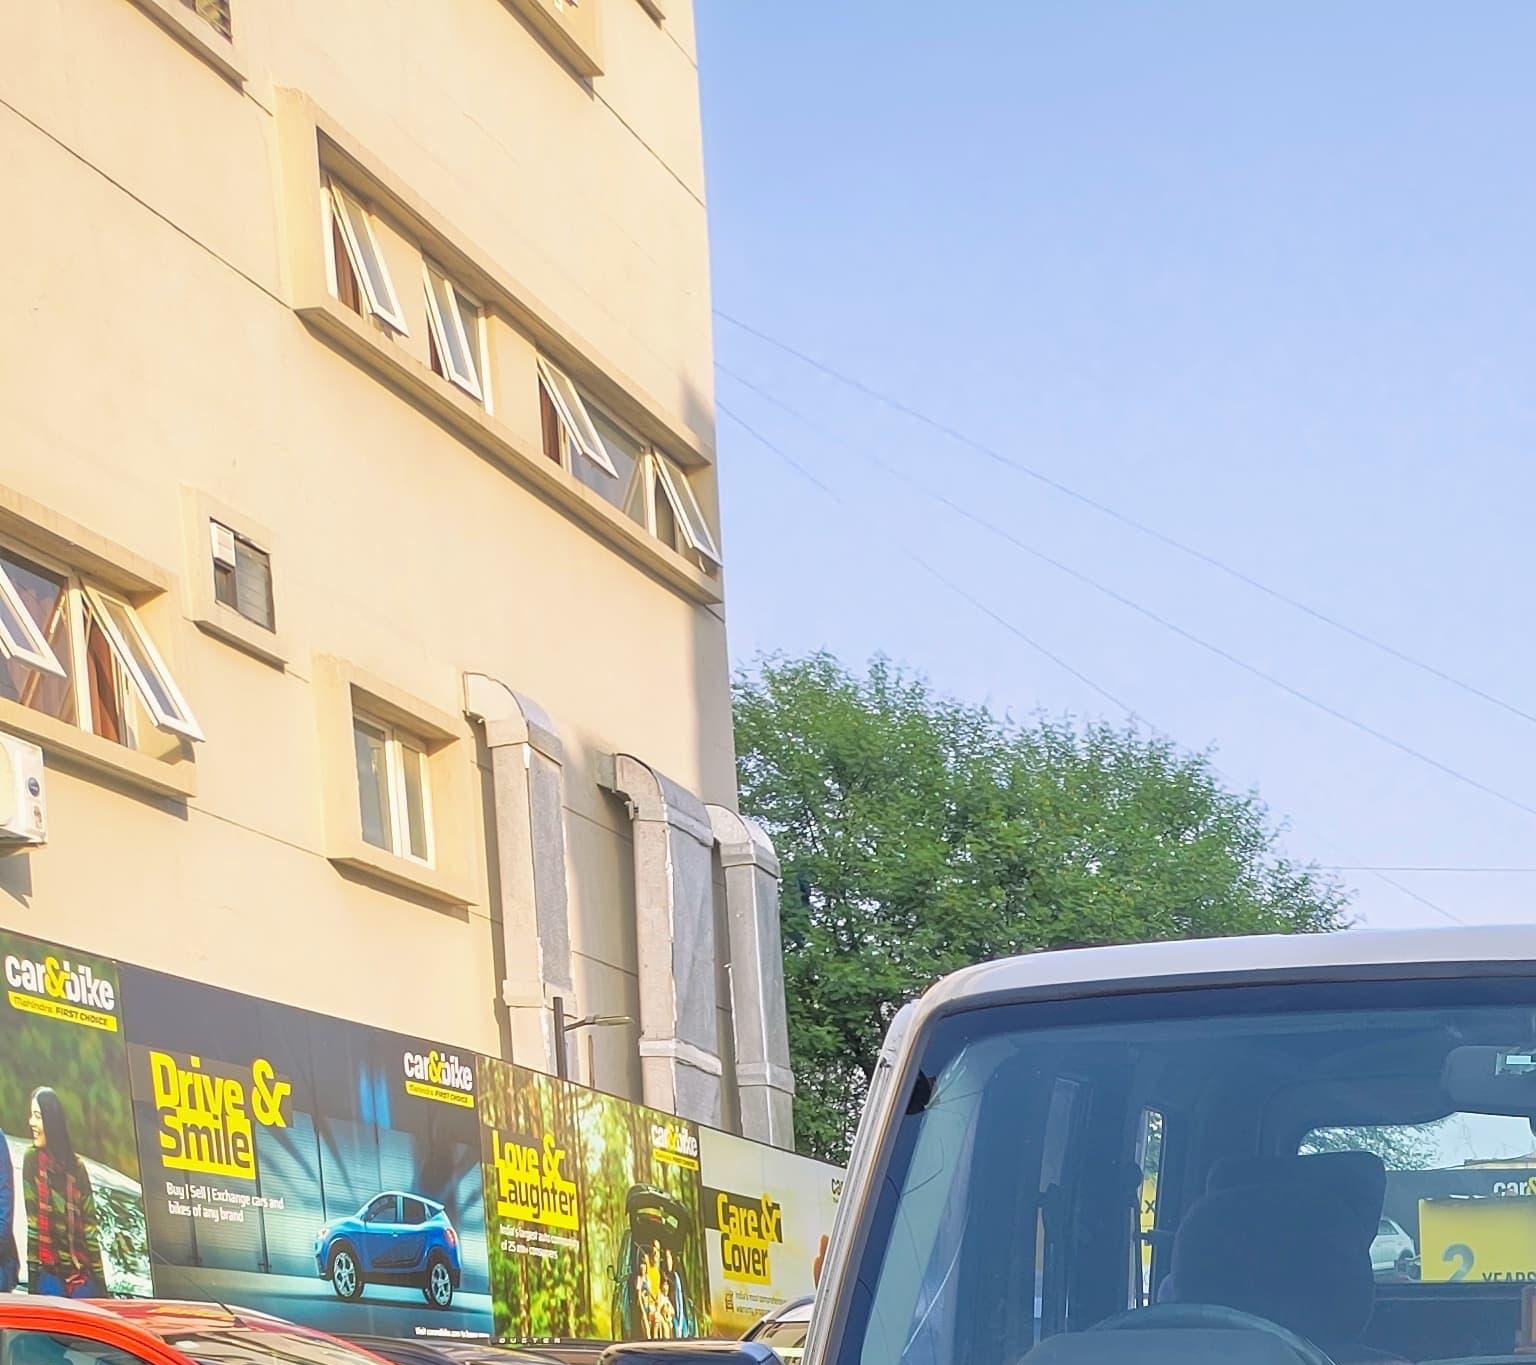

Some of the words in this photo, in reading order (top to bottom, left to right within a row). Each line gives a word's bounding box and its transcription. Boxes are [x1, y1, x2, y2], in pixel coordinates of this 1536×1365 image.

[5, 955, 115, 1010] car&bike
[150, 1051, 245, 1117] Drive
[252, 1058, 291, 1127] &
[404, 1050, 473, 1091] car&bike
[159, 1106, 251, 1169] Smile
[492, 1130, 540, 1178] Love
[543, 1134, 565, 1182] &
[166, 1182, 184, 1199] Buy
[190, 1184, 206, 1199] Sell
[212, 1188, 250, 1207] Exchange
[193, 1204, 202, 1217] of
[498, 1171, 575, 1218] Laughter
[717, 1193, 759, 1238] Care
[761, 1192, 781, 1242] &
[721, 1232, 768, 1277] Cover
[1442, 1243, 1474, 1281] 2
